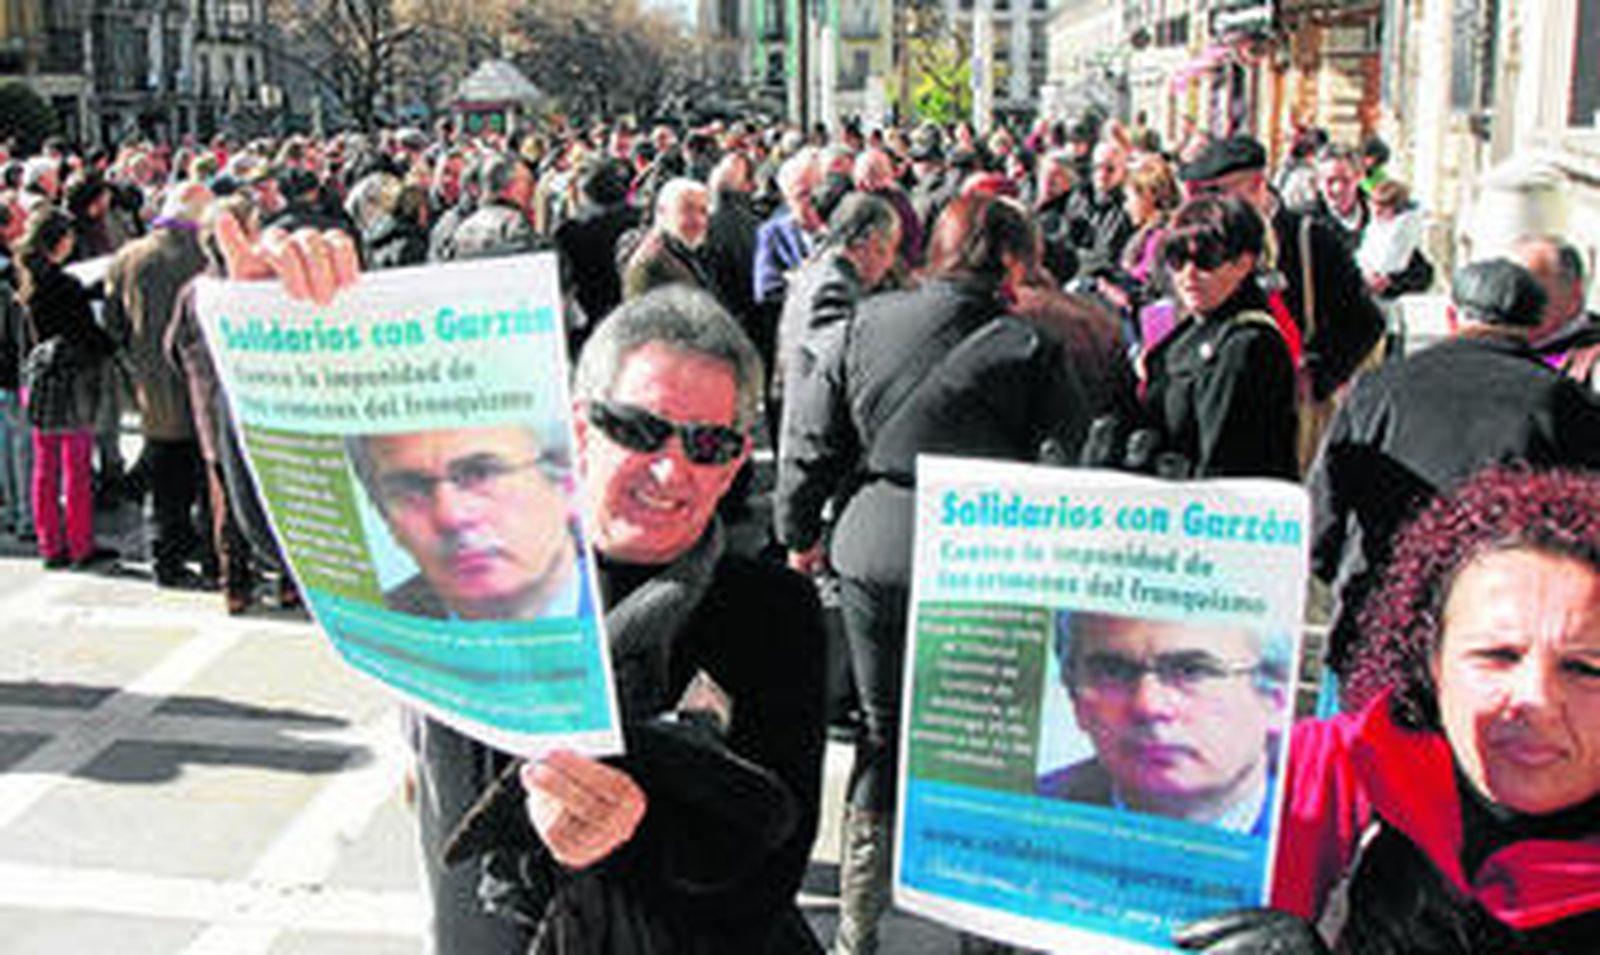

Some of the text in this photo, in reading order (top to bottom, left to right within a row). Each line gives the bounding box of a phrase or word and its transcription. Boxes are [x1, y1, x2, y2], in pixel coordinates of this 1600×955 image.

[371, 319, 425, 347] con
[939, 489, 1302, 546] Solidarios con Garzón
[1183, 550, 1213, 578] de
